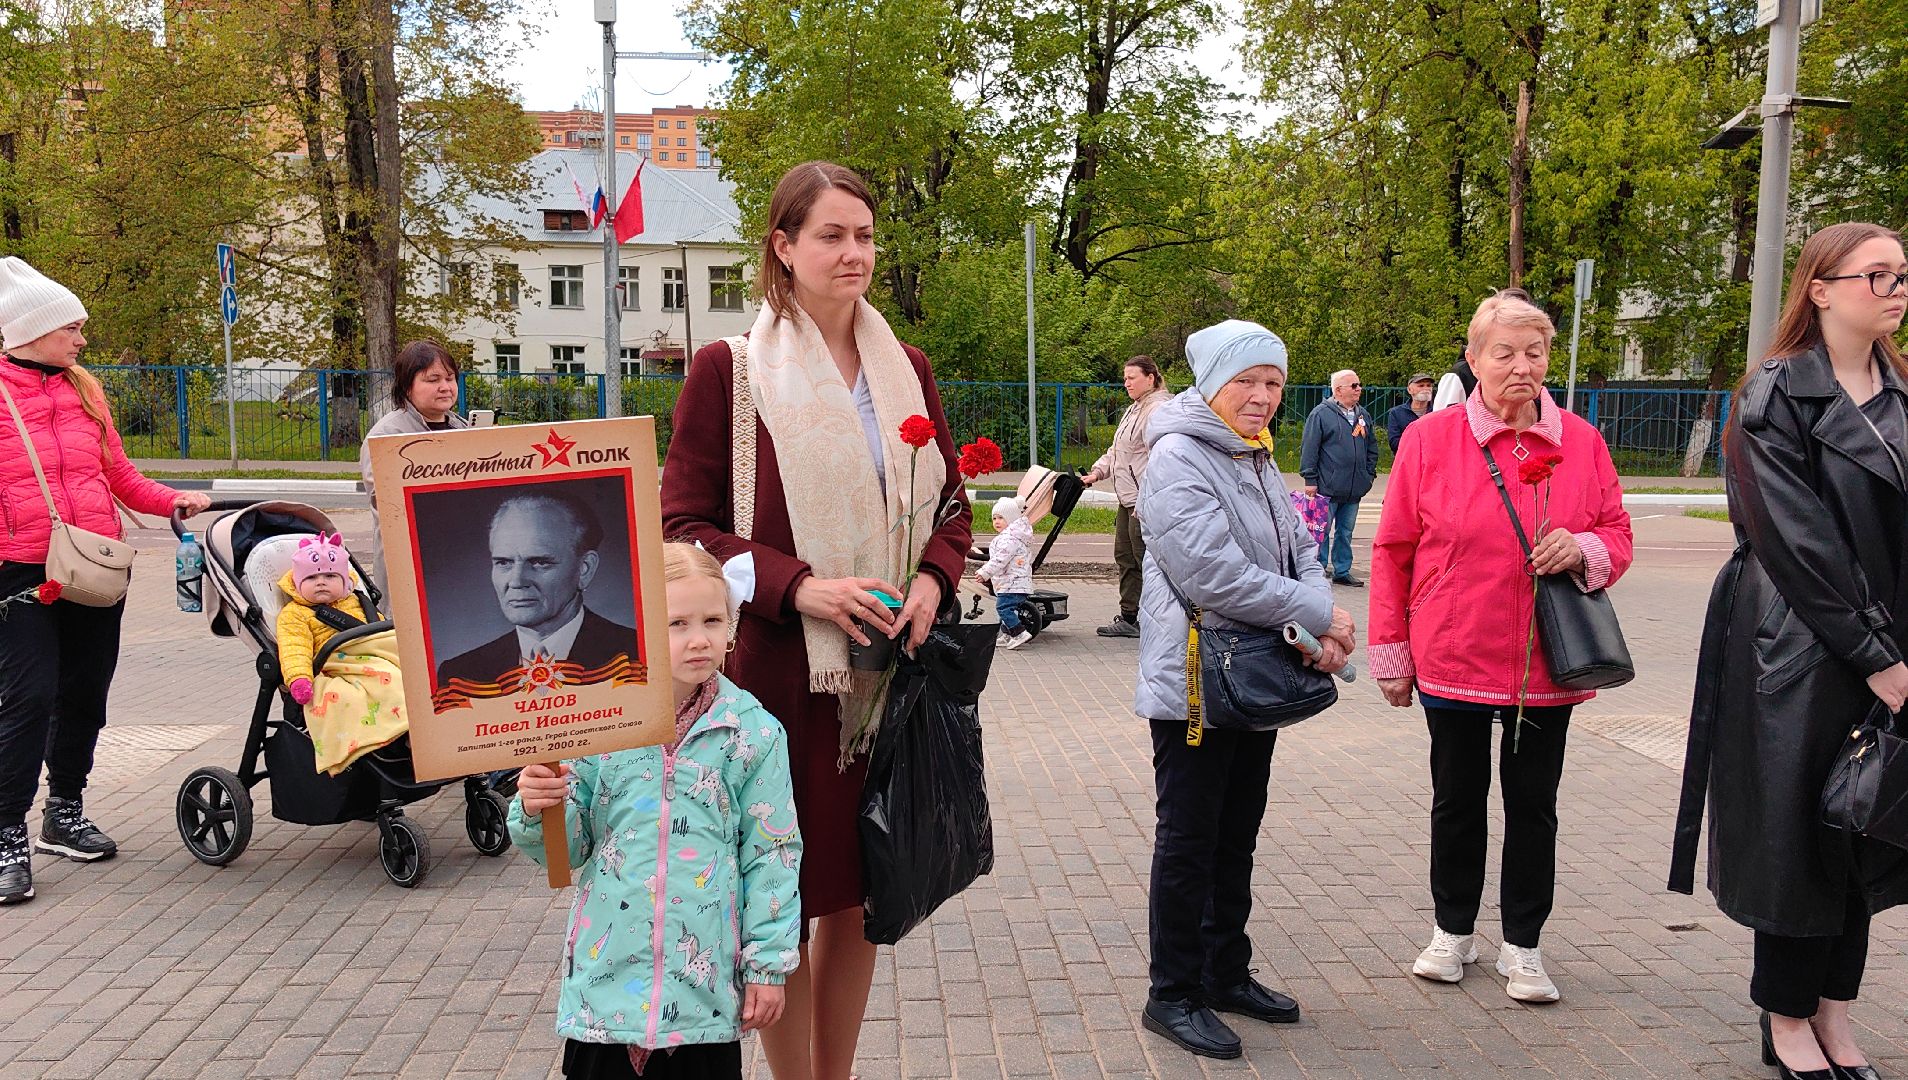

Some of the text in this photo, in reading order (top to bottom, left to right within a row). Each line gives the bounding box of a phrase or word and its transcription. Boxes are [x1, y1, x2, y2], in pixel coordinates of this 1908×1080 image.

[399, 439, 631, 480] бессмертный ПОЛК
[514, 694, 577, 714] ЧАЛОВ
[457, 720, 643, 752] Капитан 1-го ранга, Герой Советского Союза
[475, 706, 623, 737] Павел Иванович
[513, 746, 537, 757] 1921
[547, 739, 574, 751] 2000
[577, 739, 591, 747] гг.
